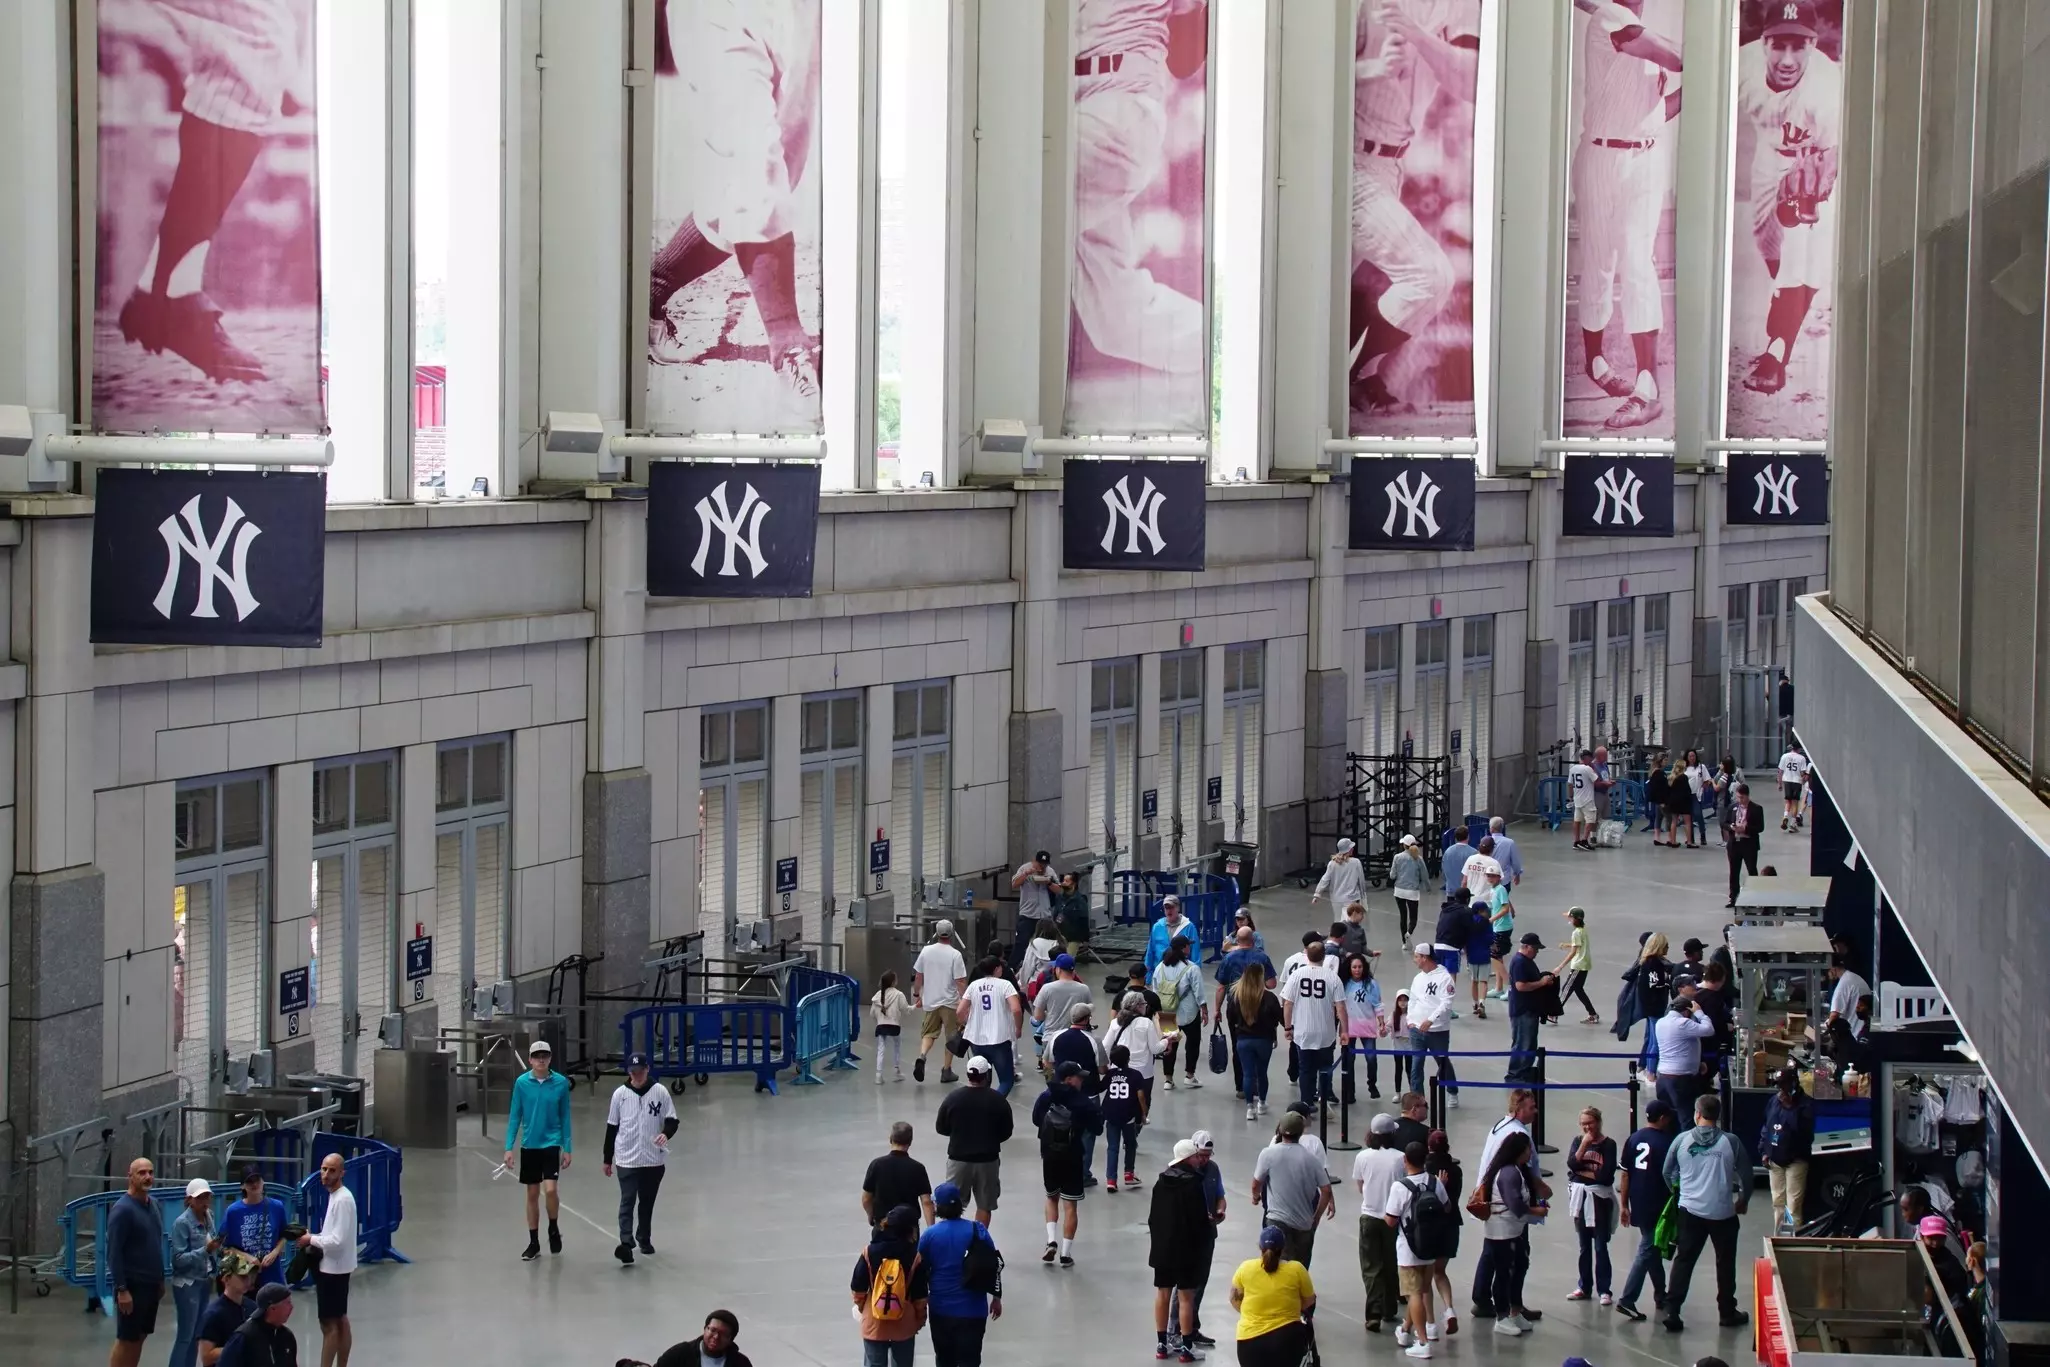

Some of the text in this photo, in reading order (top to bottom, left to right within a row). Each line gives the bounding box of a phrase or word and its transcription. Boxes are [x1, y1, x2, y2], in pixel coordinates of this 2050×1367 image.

[1593, 467, 1644, 525] NY
[1753, 464, 1799, 515] NY
[1101, 475, 1166, 555] NY
[1383, 470, 1441, 537] NY
[691, 481, 771, 578] NY
[153, 494, 262, 622] NY
[1300, 978, 1326, 999] 99
[1354, 989, 1366, 1003] NY
[1425, 982, 1438, 996] NY
[982, 995, 991, 1010] 9
[1110, 1083, 1129, 1099] 99
[648, 1101, 662, 1117] NY
[1635, 1143, 1649, 1169] 2
